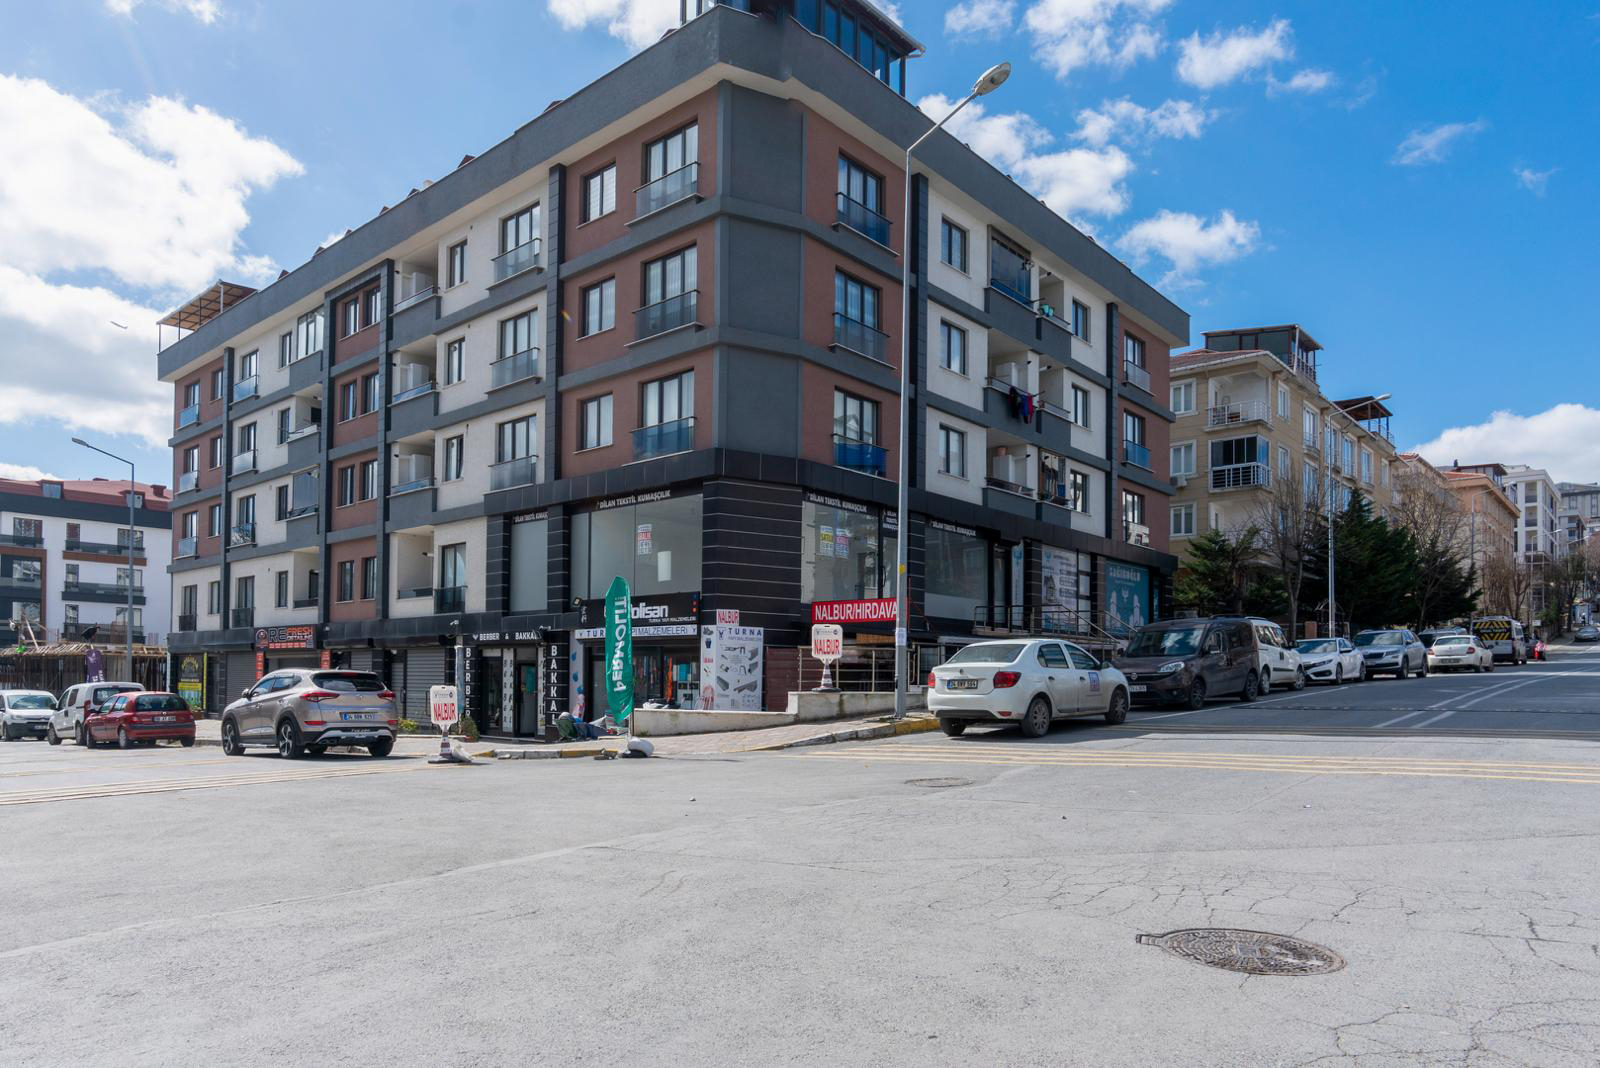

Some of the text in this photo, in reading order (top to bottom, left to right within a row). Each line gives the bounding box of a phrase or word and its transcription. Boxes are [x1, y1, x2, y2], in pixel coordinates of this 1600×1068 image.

[631, 602, 669, 620] olisan
[717, 610, 739, 625] NALBUR
[815, 601, 898, 621] NALBUR/HIRDAVA
[480, 632, 500, 641] BERBER
[587, 629, 605, 638] TUR
[728, 627, 762, 636] TURNA
[815, 639, 840, 655] NALBUR
[433, 703, 456, 721] NALBUR
